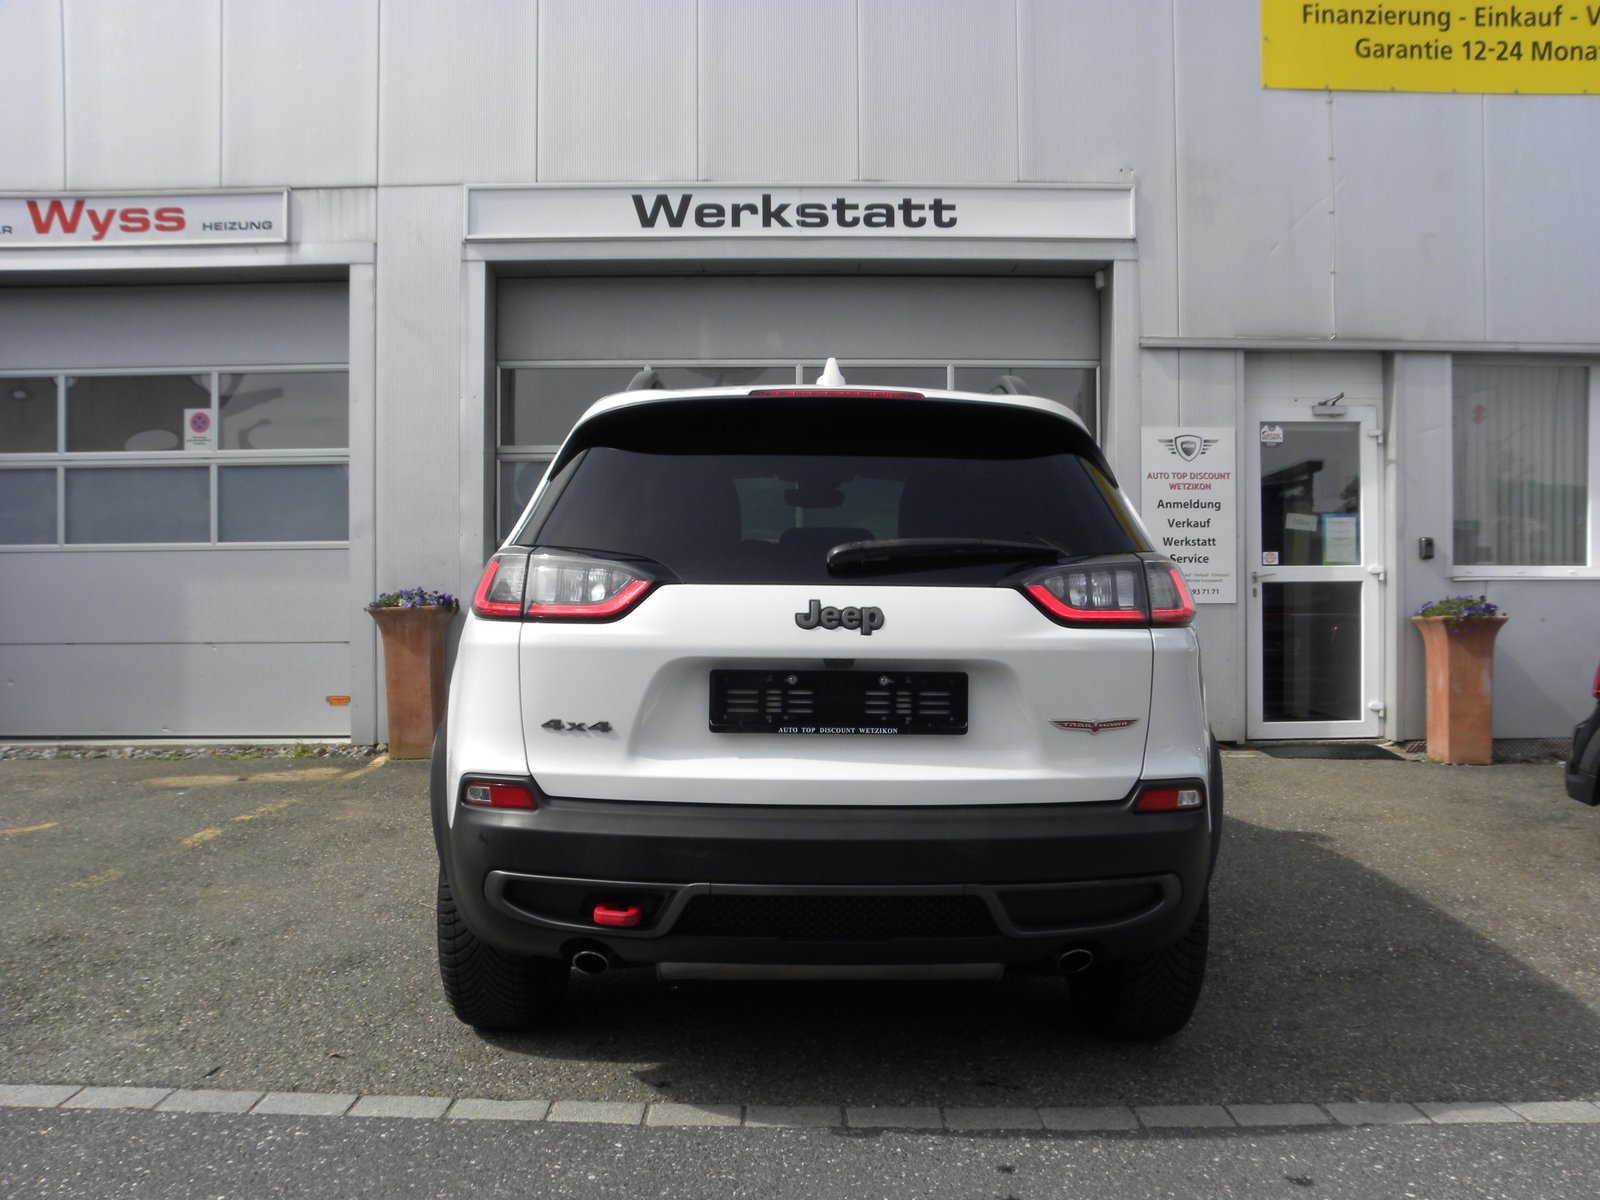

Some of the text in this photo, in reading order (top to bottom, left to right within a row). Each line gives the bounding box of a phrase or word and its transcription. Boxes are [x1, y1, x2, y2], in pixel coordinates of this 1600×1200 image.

[1302, 3, 1451, 32] Finanzierung
[1474, 4, 1563, 27] Einkauf
[1355, 37, 1600, 62] Garantie 12-24 Mona
[631, 193, 958, 229] Werkstatt
[0, 199, 273, 242] R Wyss HEIZUNG
[1147, 472, 1231, 480] AUTO TOP DISCOUNT
[1169, 483, 1212, 491] WETZIKON
[1157, 499, 1221, 511] Anmeldung
[1168, 518, 1211, 528] Verkauf
[1163, 537, 1216, 547] Werkstatt
[1170, 554, 1209, 563] Service
[795, 599, 885, 636] Jeep
[541, 719, 612, 733] 4x4
